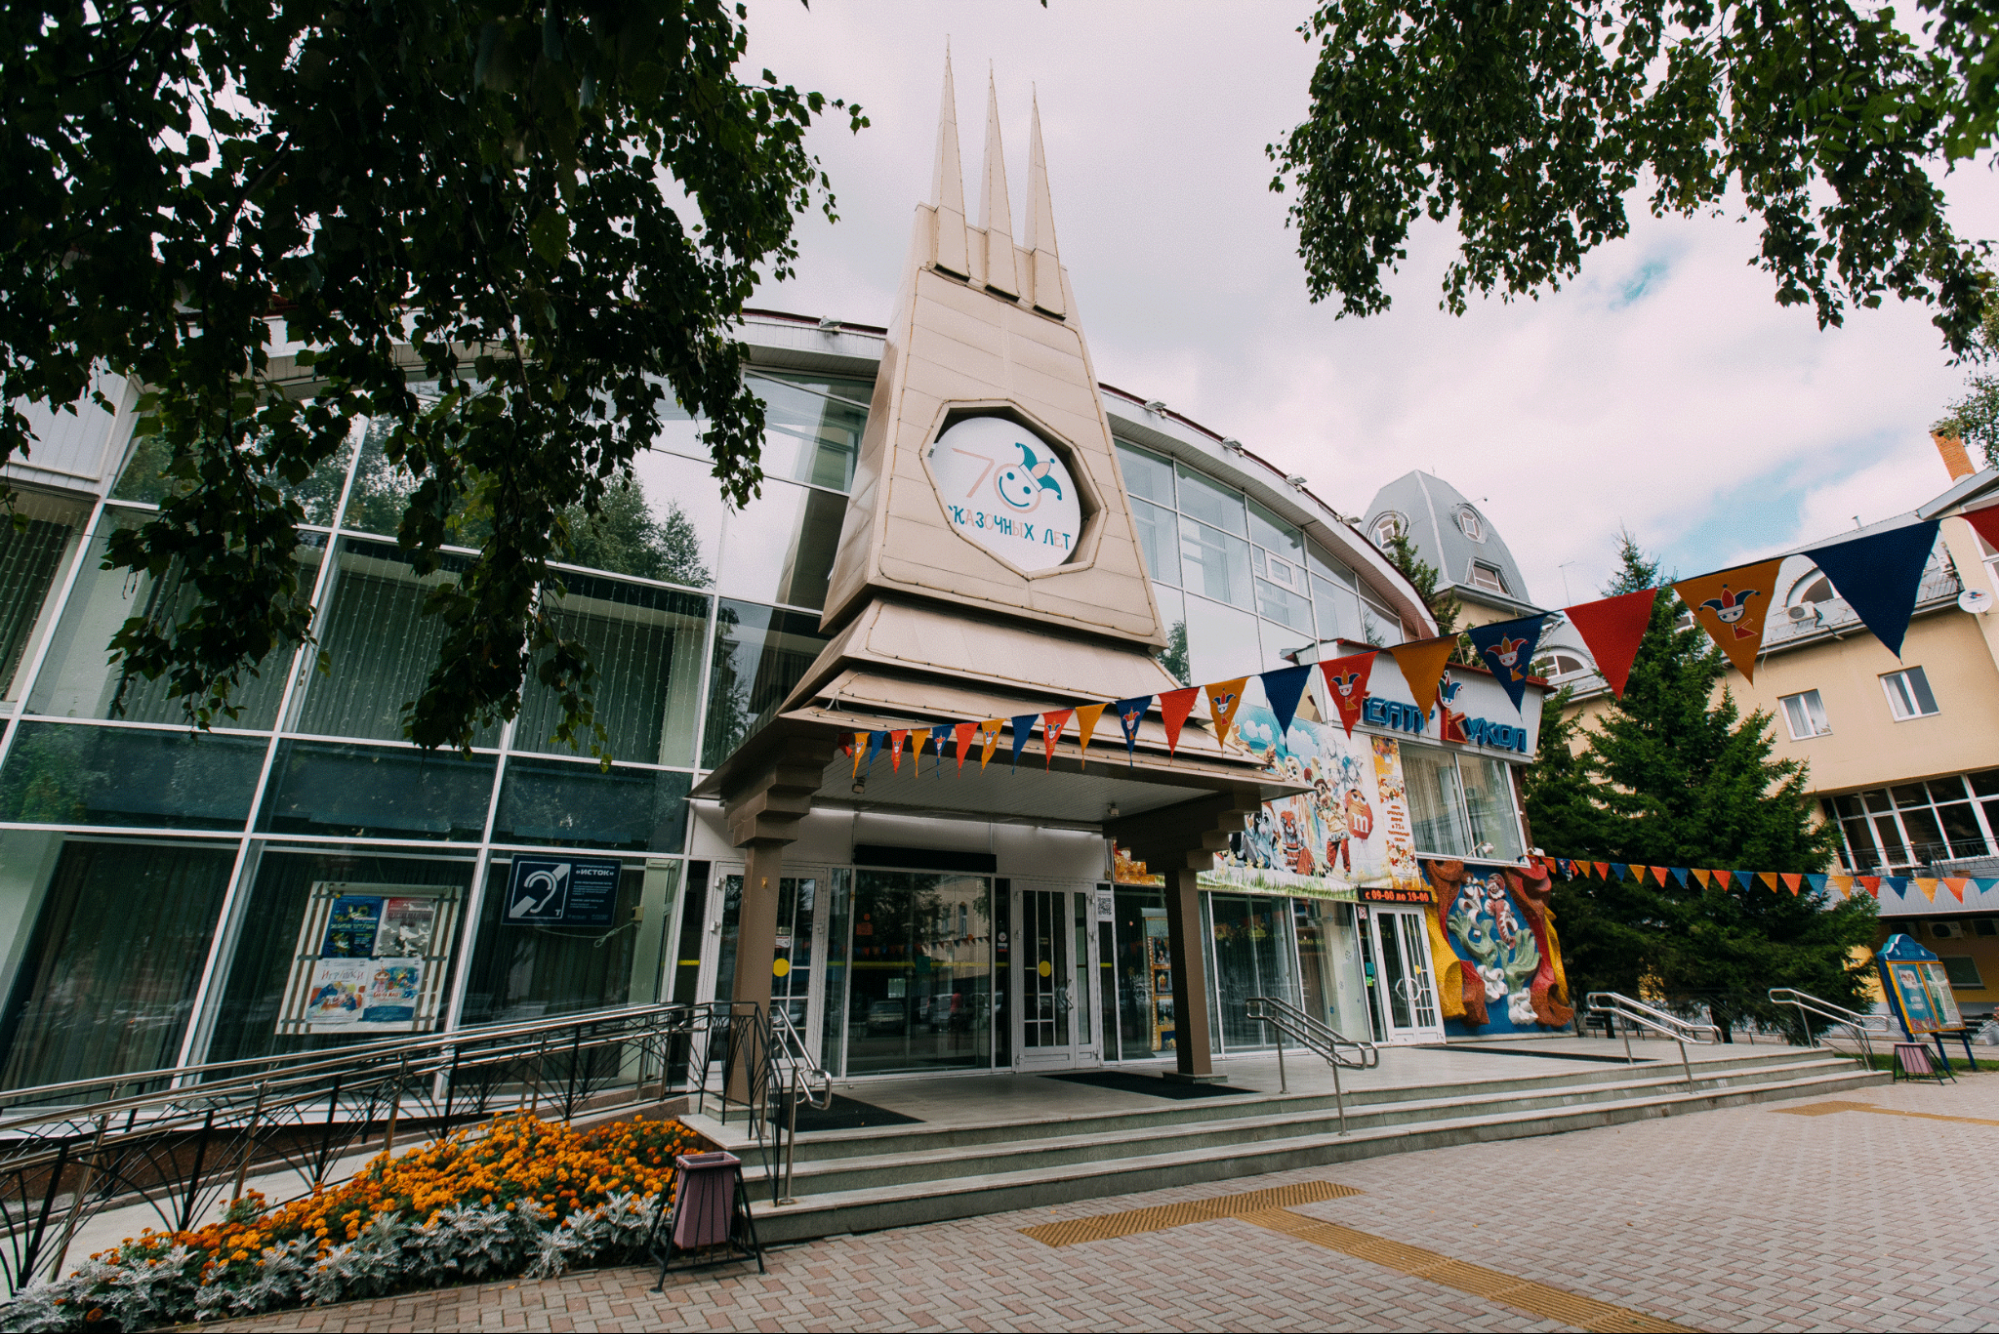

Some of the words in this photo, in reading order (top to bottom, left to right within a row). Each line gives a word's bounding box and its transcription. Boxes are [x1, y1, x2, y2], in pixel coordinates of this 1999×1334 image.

[948, 505, 1035, 541] КАЗОЧНЫХ
[1043, 528, 1071, 550] ЛЕТ
[1363, 695, 1436, 734] ЕАТР
[1371, 890, 1394, 901] 09-00
[1407, 892, 1429, 903] 19-00
